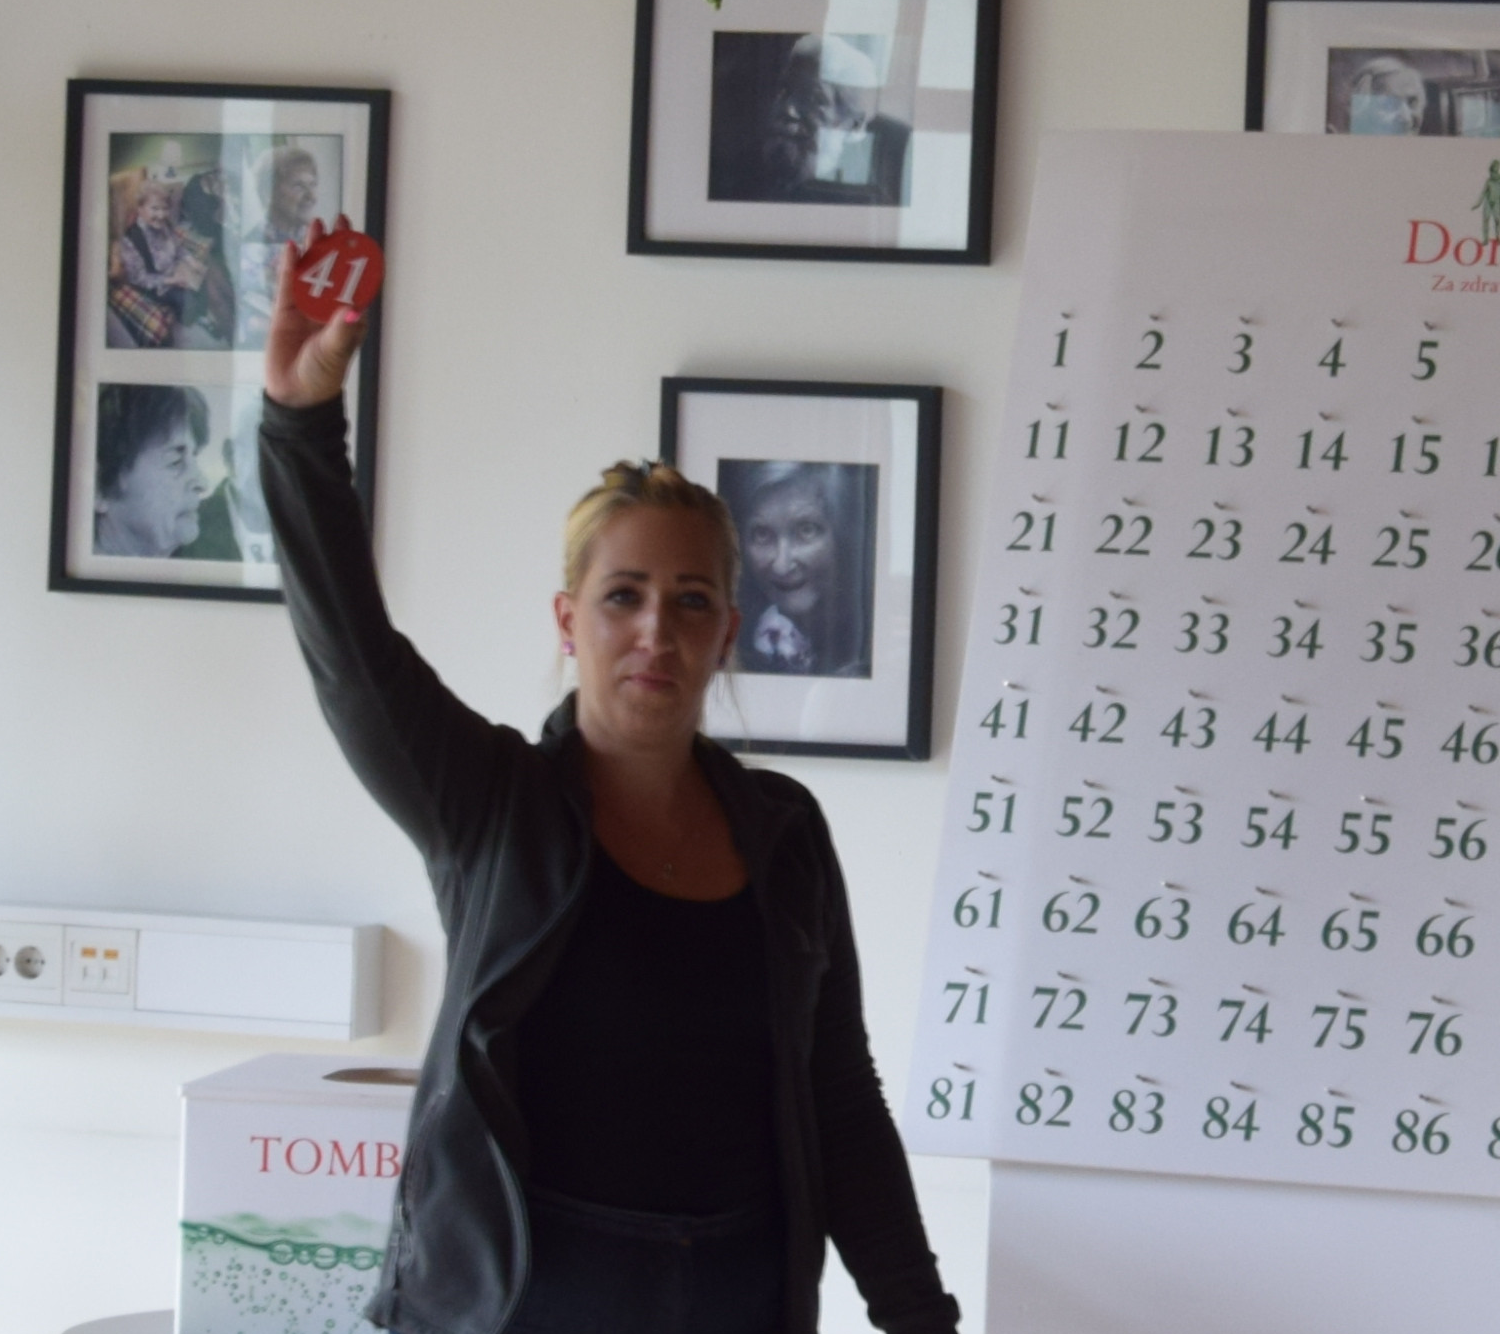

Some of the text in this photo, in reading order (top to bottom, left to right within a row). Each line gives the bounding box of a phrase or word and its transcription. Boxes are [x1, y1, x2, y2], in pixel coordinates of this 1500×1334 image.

[298, 249, 368, 305] 41
[1431, 275, 1455, 292] Za
[1052, 329, 1069, 367] 1
[1136, 329, 1165, 371] 2
[1230, 332, 1254, 375] 3
[1317, 337, 1346, 378] 4
[1412, 340, 1440, 381] 5
[1027, 420, 1069, 460] 11
[1115, 421, 1166, 463] 12
[1205, 425, 1256, 468] 13
[1297, 429, 1348, 471] 14
[1391, 433, 1442, 476] 15
[1006, 511, 1055, 552] 21
[1098, 514, 1153, 556] 22
[1187, 517, 1243, 561] 23
[1280, 522, 1336, 563] 24
[1371, 525, 1430, 570] 25
[993, 603, 1043, 645] 31
[1083, 608, 1141, 650] 32
[1173, 612, 1230, 655] 33
[1267, 615, 1323, 660] 34
[1360, 621, 1417, 663] 35
[980, 697, 1028, 739] 41
[1068, 702, 1127, 744] 42
[1160, 706, 1217, 749] 43
[1252, 712, 1310, 753] 44
[1347, 717, 1405, 760] 45
[1440, 721, 1500, 765] 46
[967, 791, 1016, 833] 51
[1055, 795, 1114, 839] 52
[1149, 800, 1203, 844] 53
[1241, 806, 1298, 851] 54
[1334, 811, 1393, 856] 55
[1429, 816, 1488, 861] 56
[953, 886, 1002, 928] 61
[1042, 889, 1101, 934] 62
[1134, 897, 1191, 941] 63
[1227, 903, 1286, 947] 64
[1320, 909, 1380, 953] 65
[1415, 914, 1475, 959] 66
[944, 981, 989, 1024] 71
[1034, 986, 1088, 1031] 72
[1125, 992, 1178, 1038] 73
[1218, 998, 1272, 1043] 74
[1312, 1004, 1366, 1050] 75
[1406, 1012, 1463, 1057] 76
[926, 1077, 975, 1121] 81
[1015, 1082, 1074, 1128] 82
[1108, 1089, 1165, 1135] 83
[1202, 1096, 1260, 1142] 84
[1296, 1102, 1355, 1149] 85
[1391, 1111, 1451, 1155] 86
